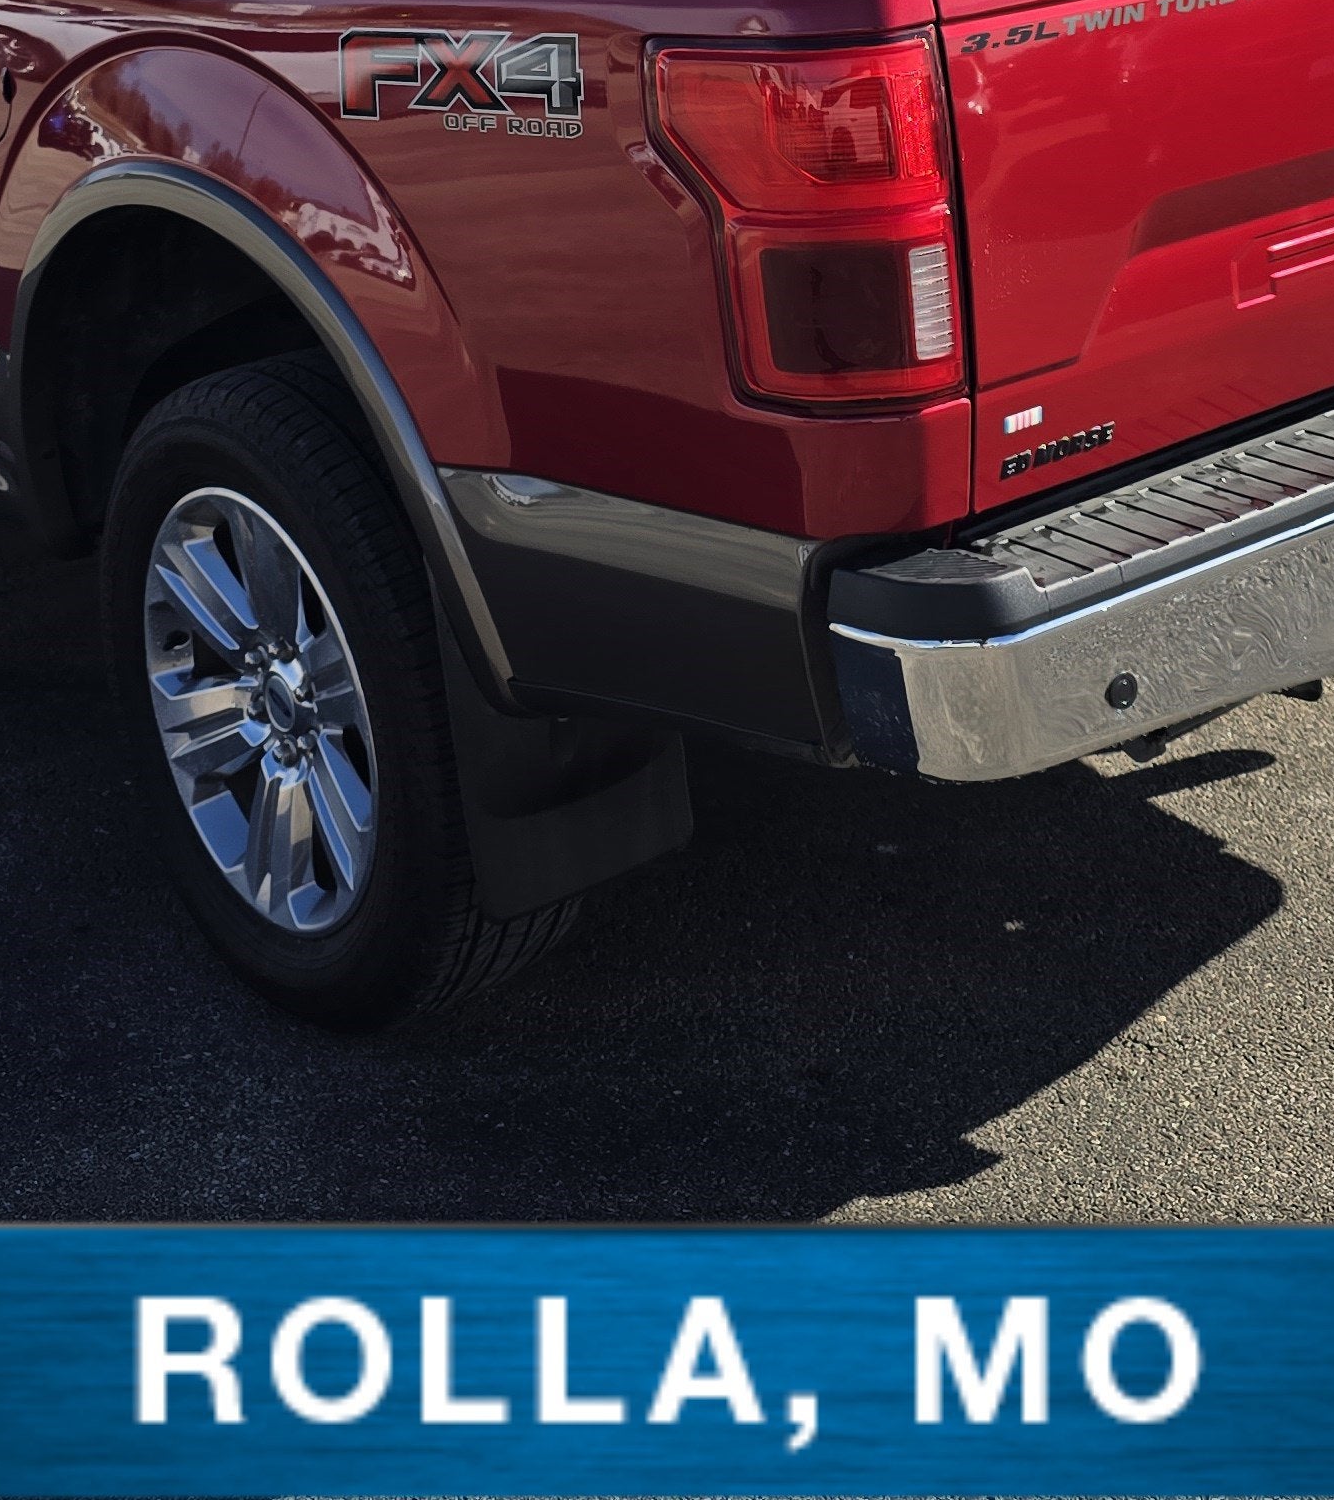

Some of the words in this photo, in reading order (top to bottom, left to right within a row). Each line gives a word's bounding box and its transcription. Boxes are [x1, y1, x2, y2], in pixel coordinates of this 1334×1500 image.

[960, 21, 1060, 53] 3.5L
[1062, 2, 1146, 36] TWIN
[338, 26, 585, 121] FX4
[443, 112, 497, 133] OFF
[506, 115, 584, 139] ROAD
